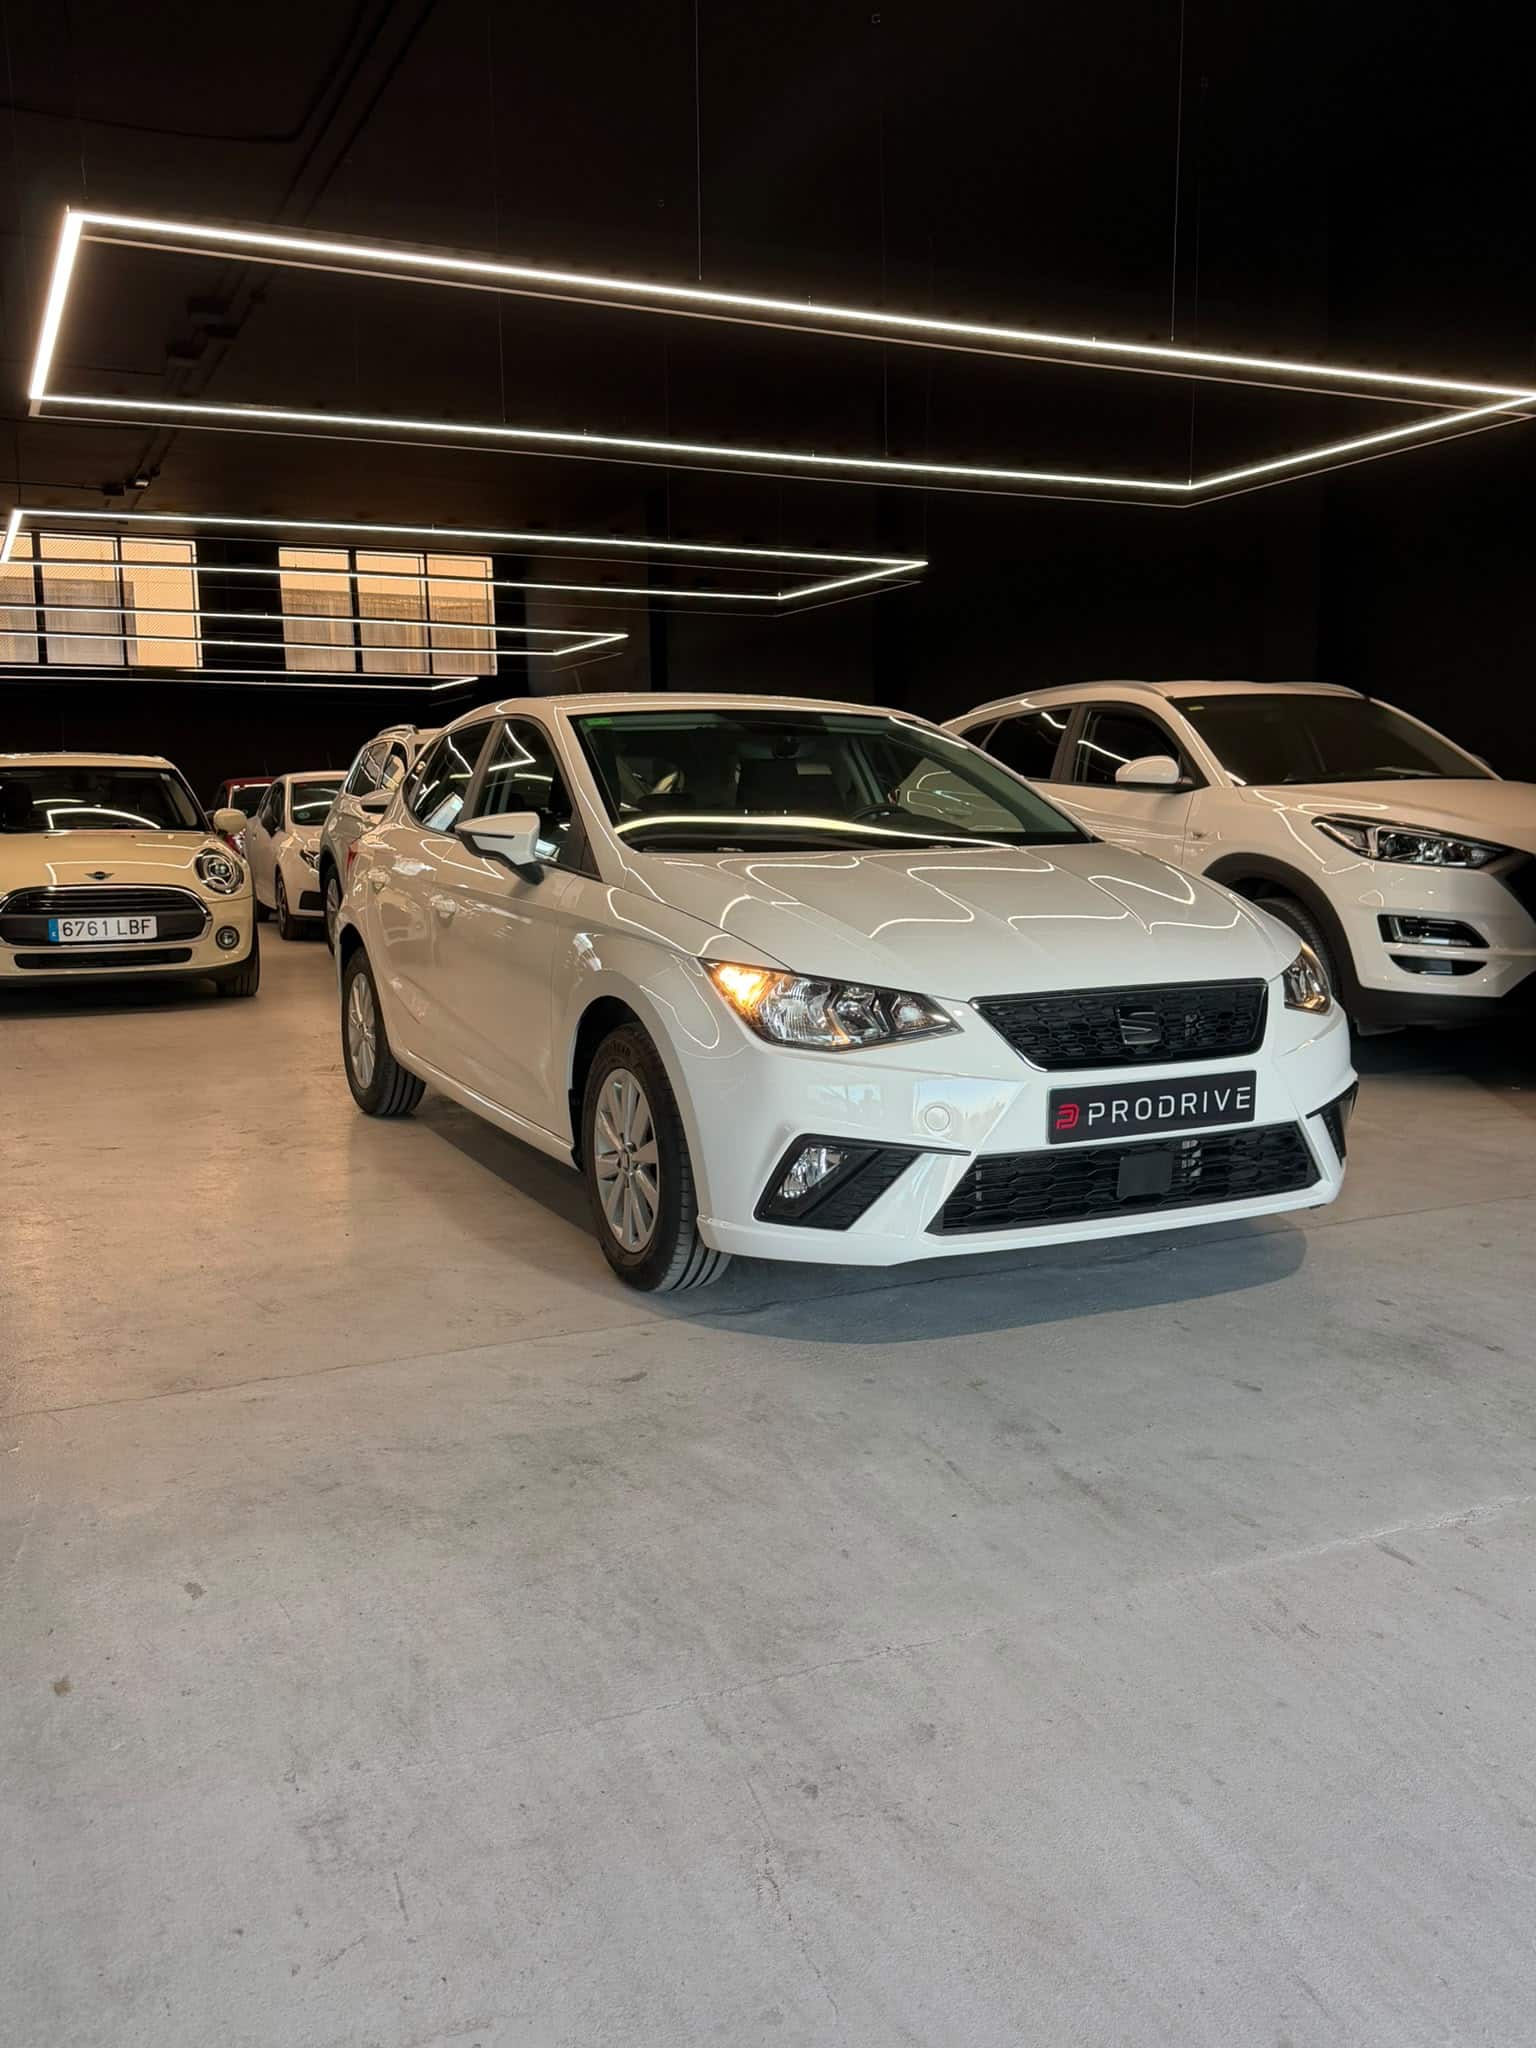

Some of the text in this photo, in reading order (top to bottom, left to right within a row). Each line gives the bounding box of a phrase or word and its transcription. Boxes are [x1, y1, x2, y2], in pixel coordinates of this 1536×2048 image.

[62, 919, 152, 937] 6761 LBF
[1088, 1086, 1251, 1126] PRODRIVE
